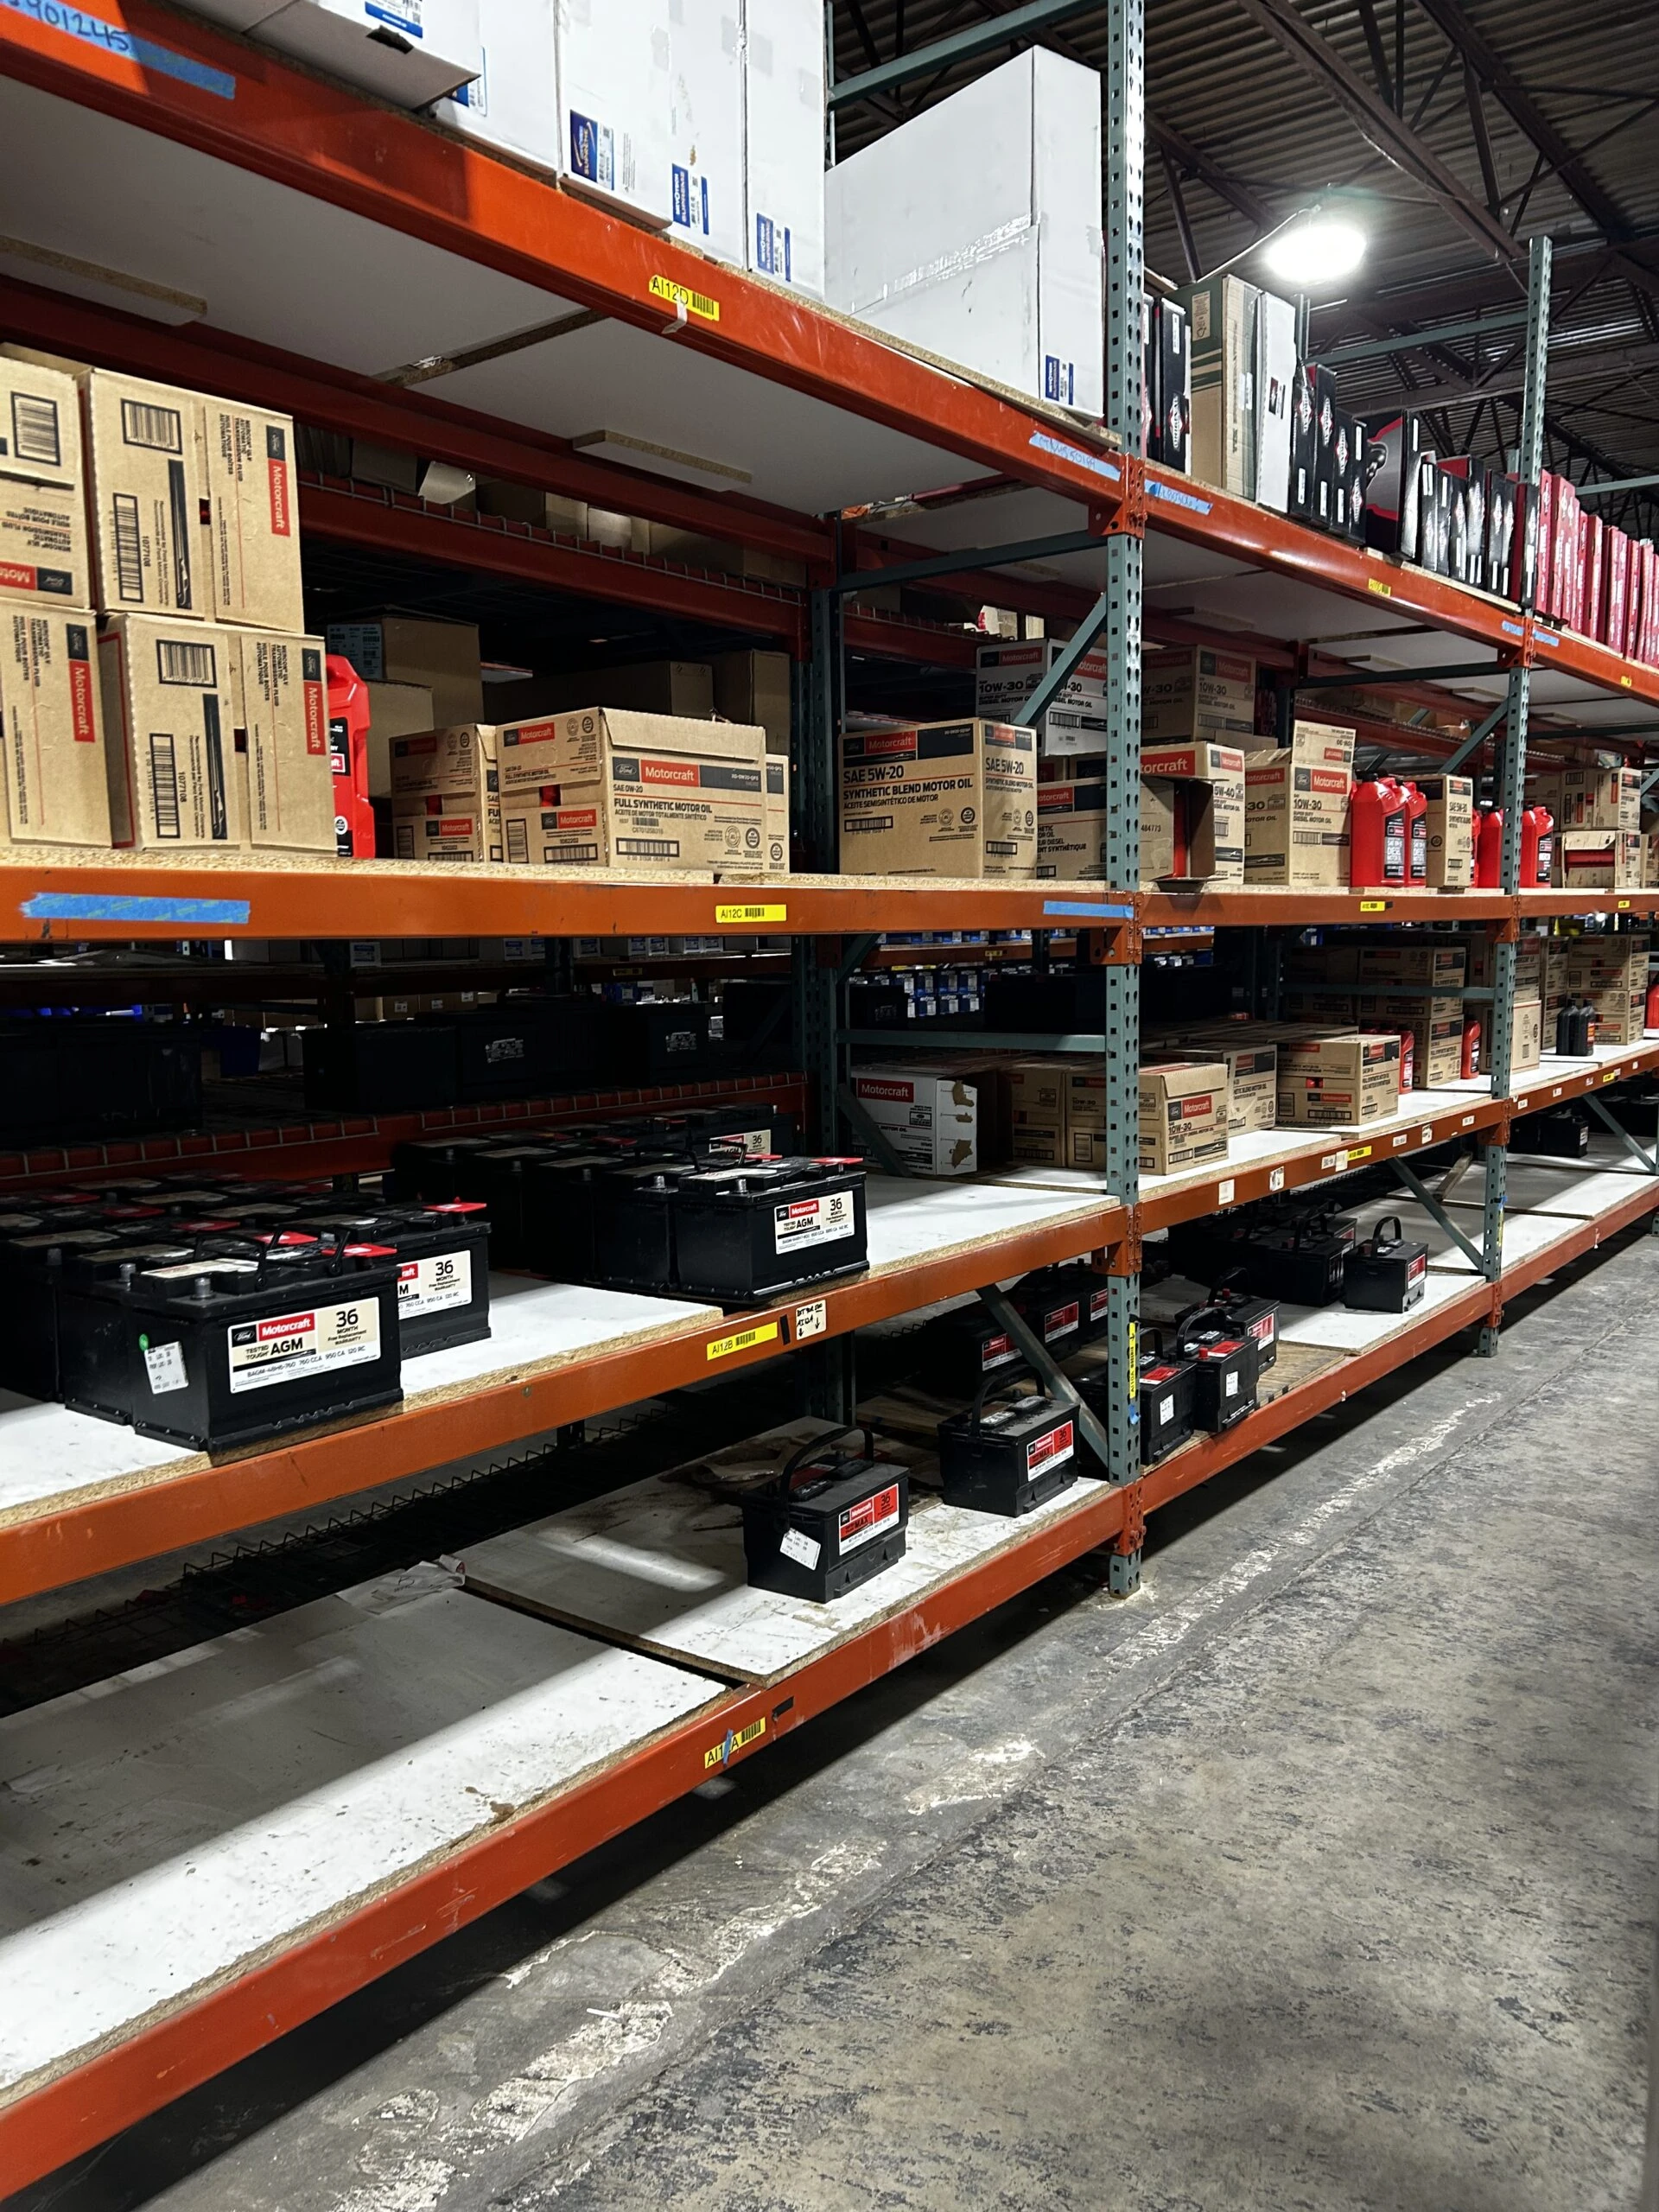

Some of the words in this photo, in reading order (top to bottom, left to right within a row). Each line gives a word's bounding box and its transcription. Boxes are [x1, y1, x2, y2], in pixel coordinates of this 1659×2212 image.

[652, 276, 690, 305] AI12D
[273, 466, 285, 530] Motorcraft
[1002, 652, 1039, 662] Motorcraft
[1219, 661, 1249, 677] Motorcraft
[979, 681, 1024, 692] 10W-30
[1199, 681, 1227, 695] 10W-30
[74, 667, 90, 734] Motorcraft
[308, 687, 321, 748] Motorcraft
[521, 728, 552, 741] Motorcraft
[869, 736, 912, 750] Motorcraft
[985, 757, 1000, 772] SAE
[1001, 760, 1024, 774] 5W-20
[1222, 755, 1242, 768] Motorcraft
[617, 765, 634, 775] Ford
[645, 766, 695, 781] Motorcraft
[843, 770, 866, 784] SAE
[868, 766, 904, 781] 5W-20
[178, 772, 187, 802] 1077108
[613, 784, 624, 792] SAE
[843, 785, 890, 799] SYNTHETIC
[893, 784, 921, 796] BLEND
[923, 779, 955, 793] MOTOR
[957, 778, 974, 790] OIL
[1313, 777, 1345, 790] Motorcraft
[1214, 785, 1235, 798] 5W-40
[614, 798, 632, 808] FULL
[635, 800, 675, 810] SYNTHETIC
[675, 803, 700, 813] MOTOR
[701, 804, 713, 813] OIL
[843, 800, 862, 809] ACEITE
[864, 796, 907, 808] SEMISINTÉTICO
[917, 793, 939, 803] MOTOR
[1294, 799, 1322, 810] 10W-30
[560, 813, 594, 824] Motorcraft
[655, 811, 683, 820] TOTALMENTE
[442, 823, 469, 832] Motorcraft
[1141, 823, 1161, 832] 484773
[1048, 842, 1087, 853] SYNTHÉTIQUE
[721, 908, 743, 919] AI12C
[861, 1084, 909, 1097] Motorcraft
[1184, 1100, 1211, 1113] Motorcraft
[1168, 1122, 1192, 1135] 10W-30
[753, 1134, 762, 1145] 36
[791, 1203, 818, 1215] Motorcraft
[830, 1198, 842, 1211] 36
[796, 1217, 814, 1229] AGM
[435, 1260, 454, 1276] 36
[336, 1308, 359, 1328] 36
[262, 1317, 311, 1337] Motorcraft
[337, 1325, 359, 1334] MONTH
[236, 1331, 253, 1341] Ford
[334, 1336, 361, 1345] WARRANTY
[339, 1329, 366, 1339] Replacement
[245, 1344, 269, 1354] TESTED
[270, 1338, 303, 1355] AGM
[712, 1339, 734, 1355] AI12B
[299, 1357, 310, 1366] 760
[1058, 1428, 1067, 1440] 36
[880, 1492, 891, 1506] 36
[851, 1501, 873, 1517] Motorcraft
[855, 1515, 868, 1529] MAX
[707, 1737, 740, 1765] AI1A
